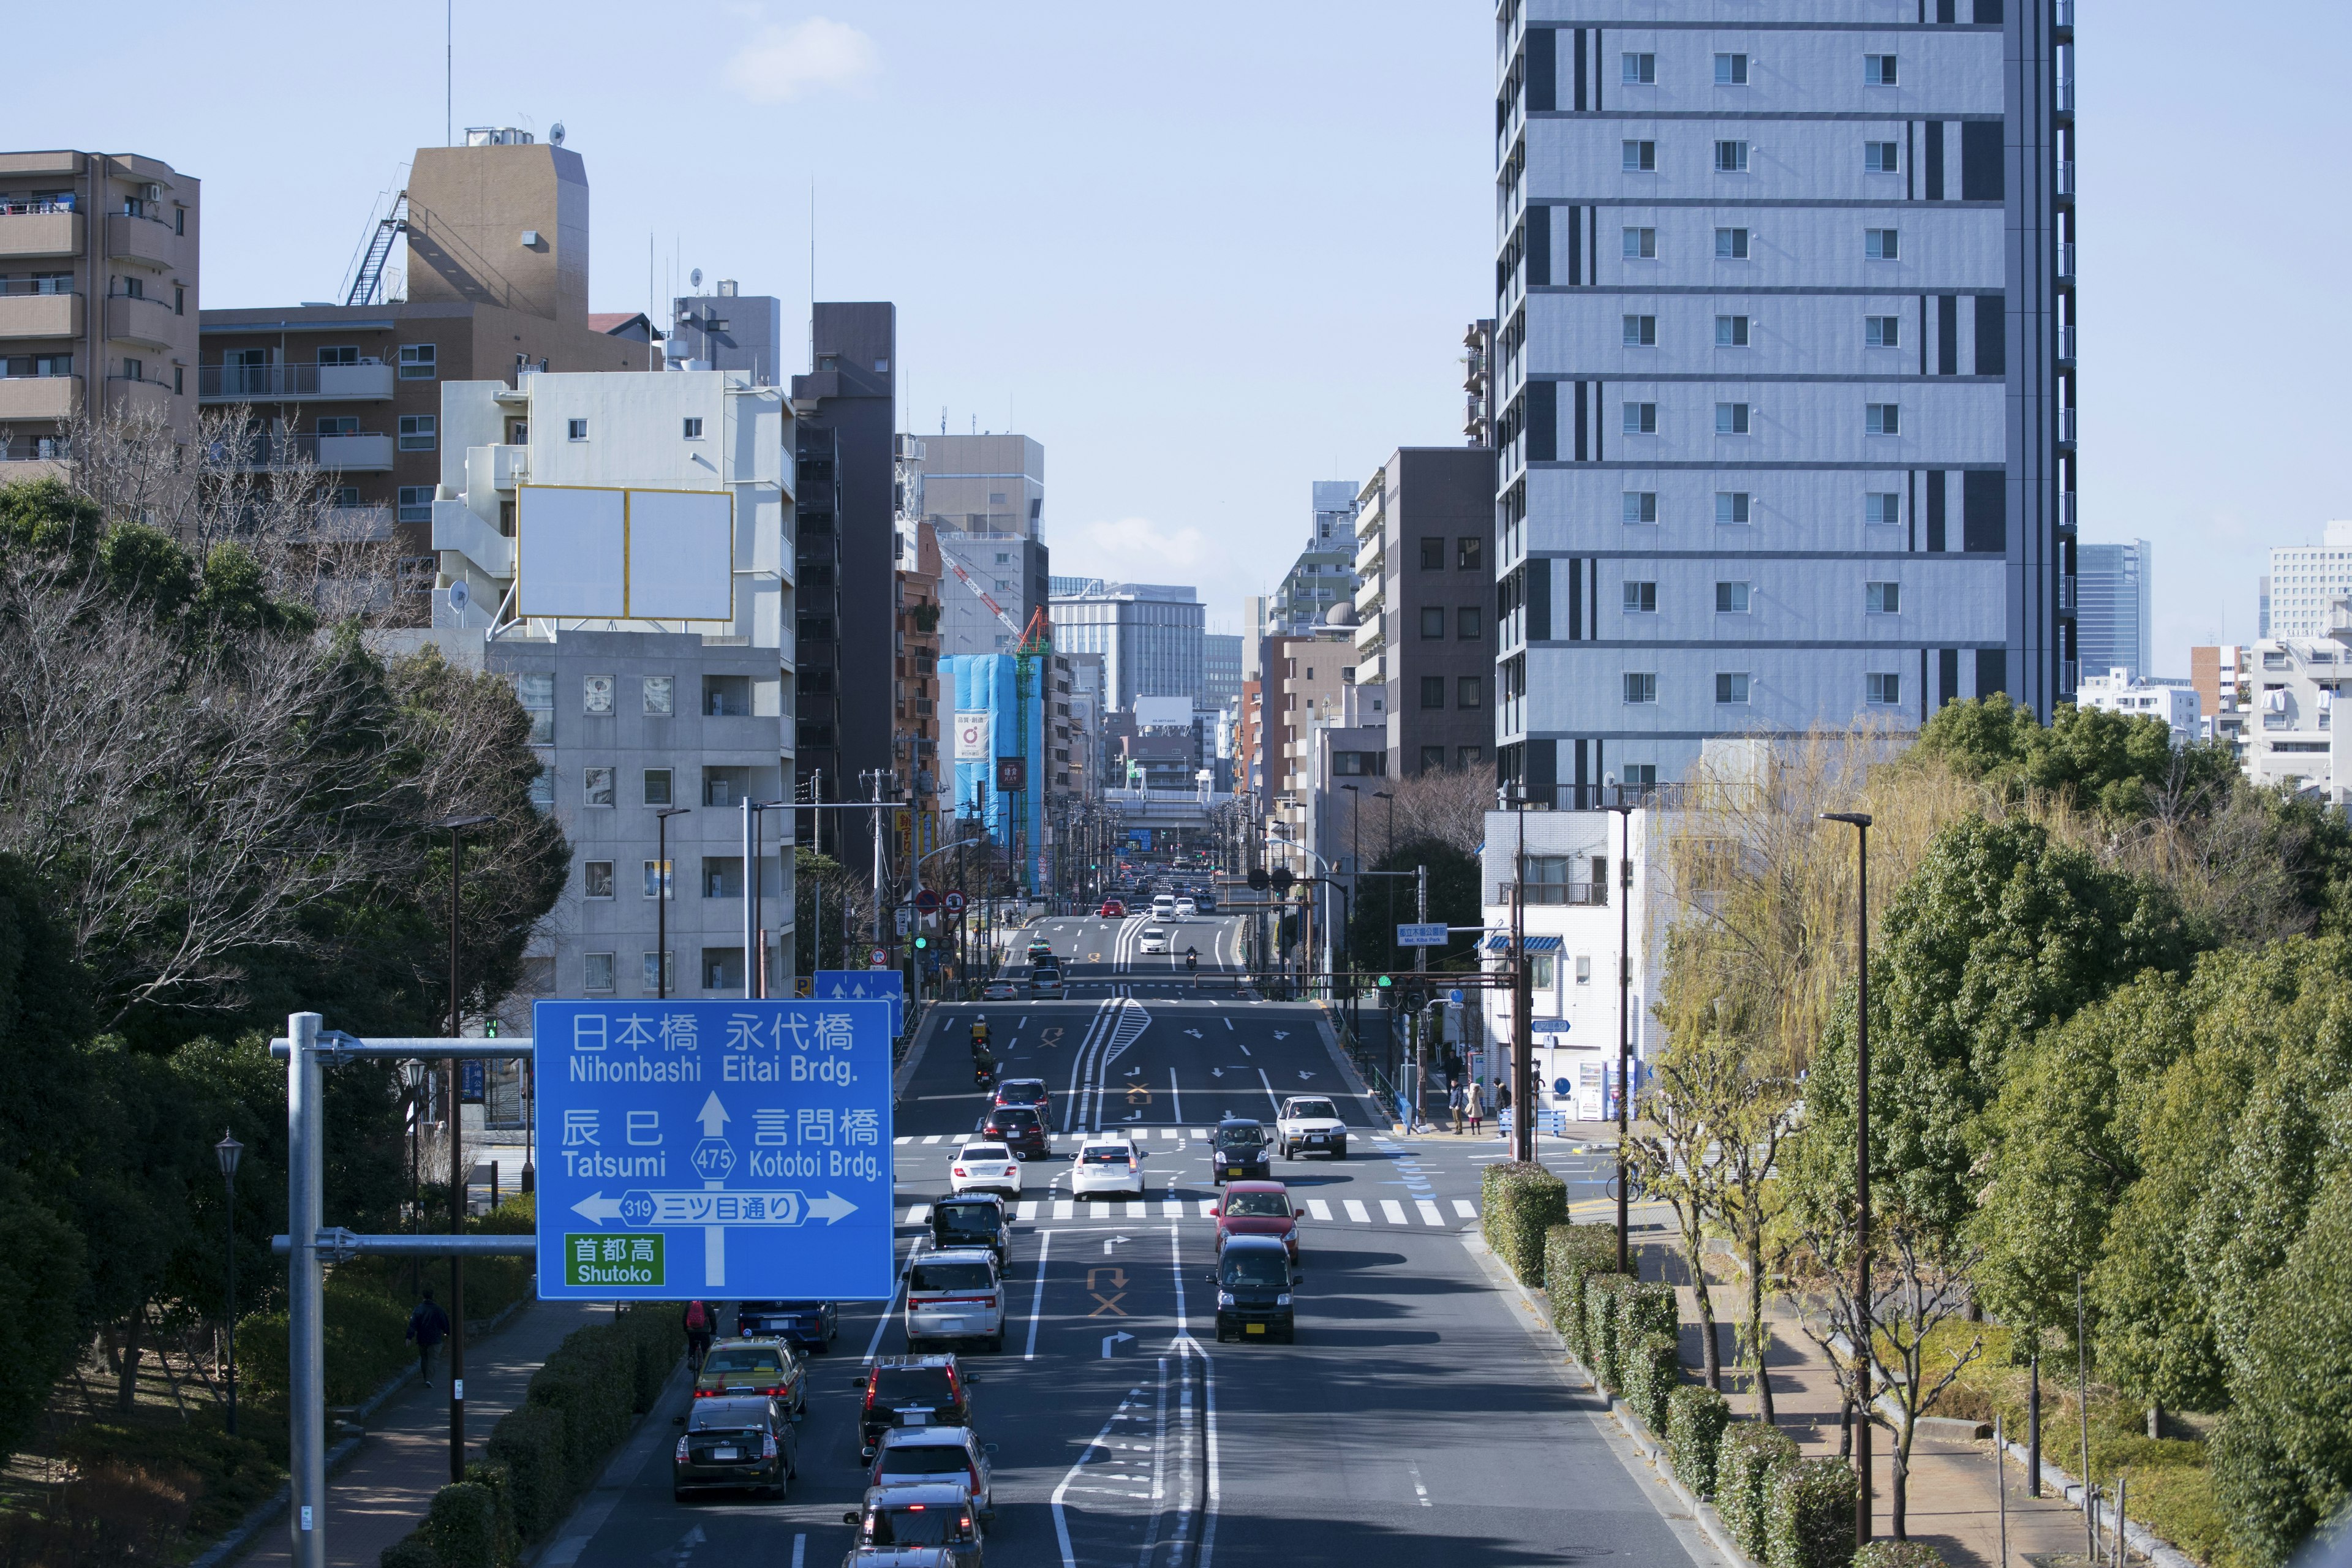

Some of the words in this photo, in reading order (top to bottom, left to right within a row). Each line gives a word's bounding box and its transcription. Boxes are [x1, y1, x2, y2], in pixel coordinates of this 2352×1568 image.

[1399, 927, 1446, 937] 都立木場公園前
[574, 1012, 698, 1051] 日本橋
[726, 1012, 854, 1051] 永代橋
[570, 1055, 701, 1082] Nihonbashi
[723, 1055, 780, 1082] Eitai
[791, 1055, 858, 1087] Brdg.
[752, 1108, 880, 1146] 言問橋
[561, 1150, 666, 1178] Tatsumi
[697, 1149, 731, 1169] 475
[750, 1150, 821, 1177] Kototoi
[830, 1150, 882, 1182] Brdg.
[624, 1199, 652, 1218] 319
[663, 1197, 790, 1220] 三ツ目通り
[574, 1238, 654, 1262] 首都高
[578, 1265, 652, 1283] Shutoko
